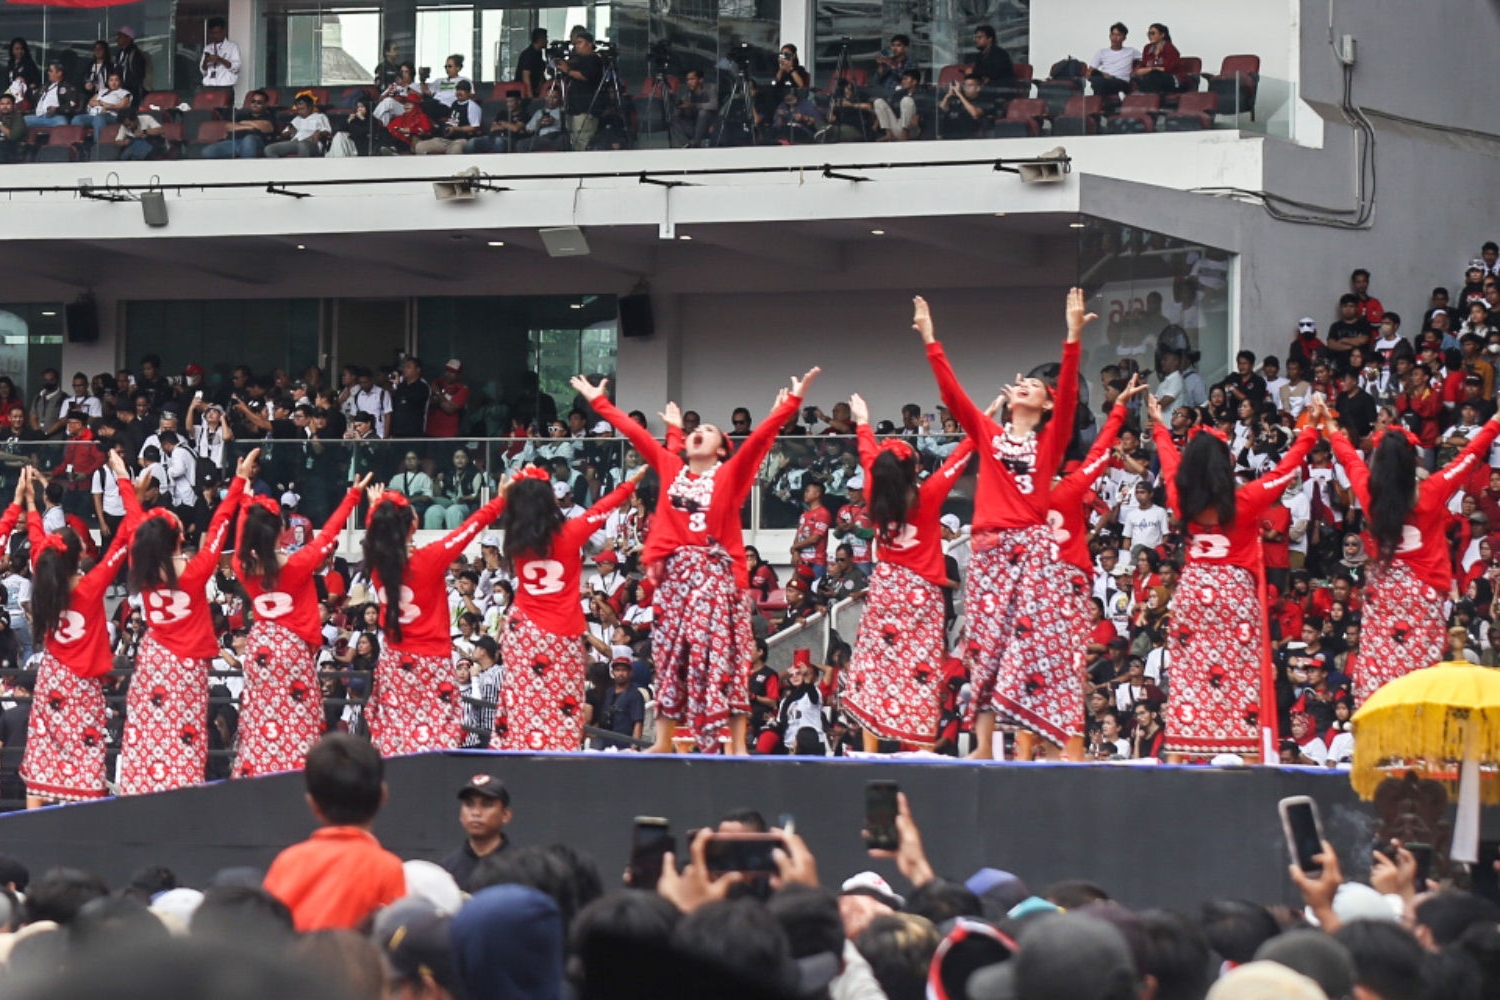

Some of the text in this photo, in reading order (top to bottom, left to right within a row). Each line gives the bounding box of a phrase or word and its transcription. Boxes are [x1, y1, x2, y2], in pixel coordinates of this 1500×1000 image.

[1014, 474, 1034, 494] 3
[688, 512, 707, 532] 3
[522, 560, 565, 596] 3
[149, 589, 192, 624] 3
